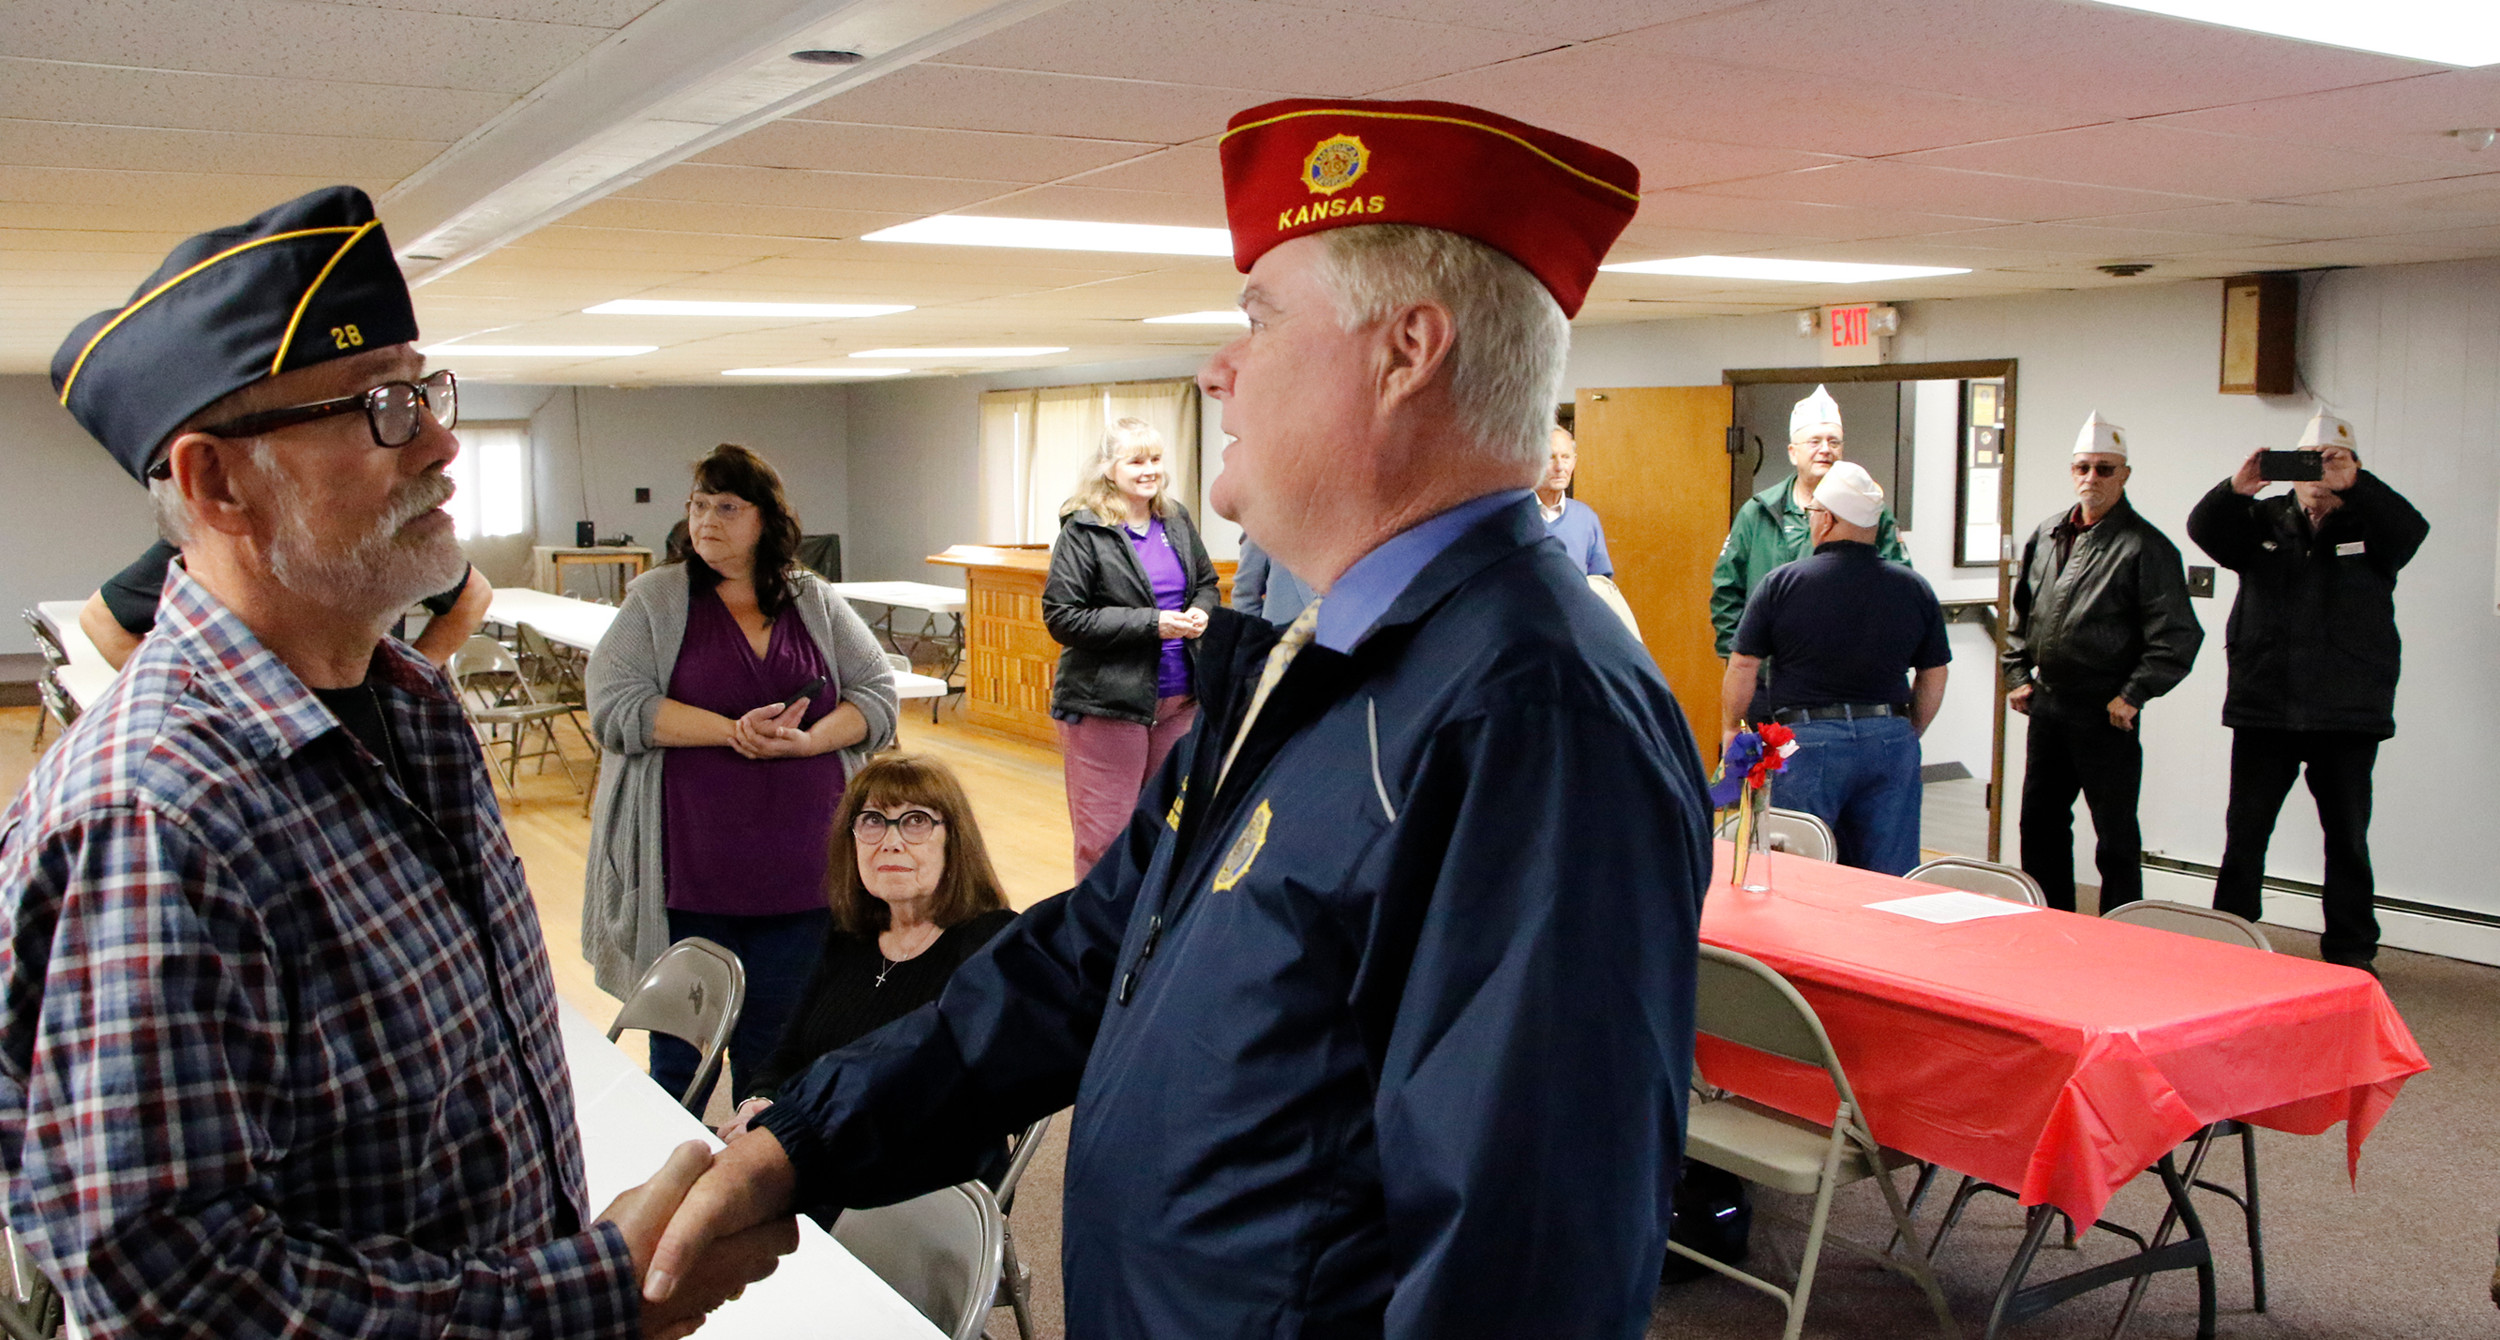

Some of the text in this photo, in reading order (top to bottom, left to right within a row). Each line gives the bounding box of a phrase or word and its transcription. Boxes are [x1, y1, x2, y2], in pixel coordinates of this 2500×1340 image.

[1278, 195, 1386, 231] KANSAS
[330, 324, 364, 350] 28
[1831, 307, 1869, 347] EXIT
